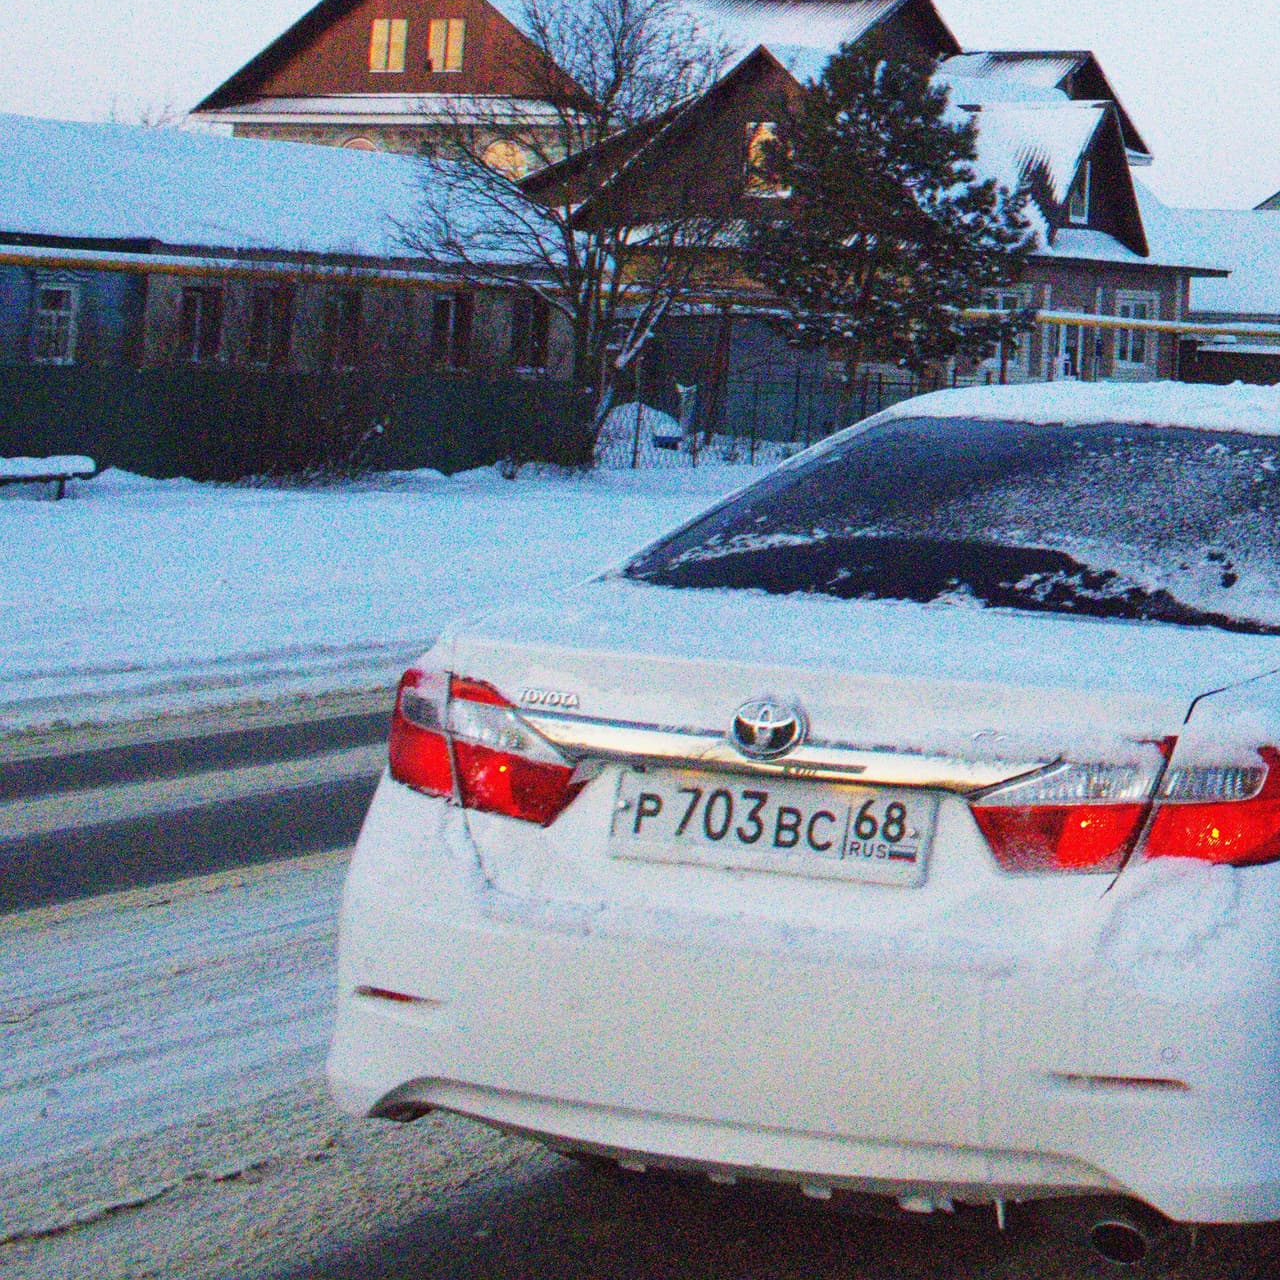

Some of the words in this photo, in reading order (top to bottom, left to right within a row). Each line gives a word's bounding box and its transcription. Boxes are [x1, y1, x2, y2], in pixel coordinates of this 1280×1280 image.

[520, 687, 580, 709] TOYOTA
[854, 799, 909, 843] 68
[848, 840, 888, 860] RUS
